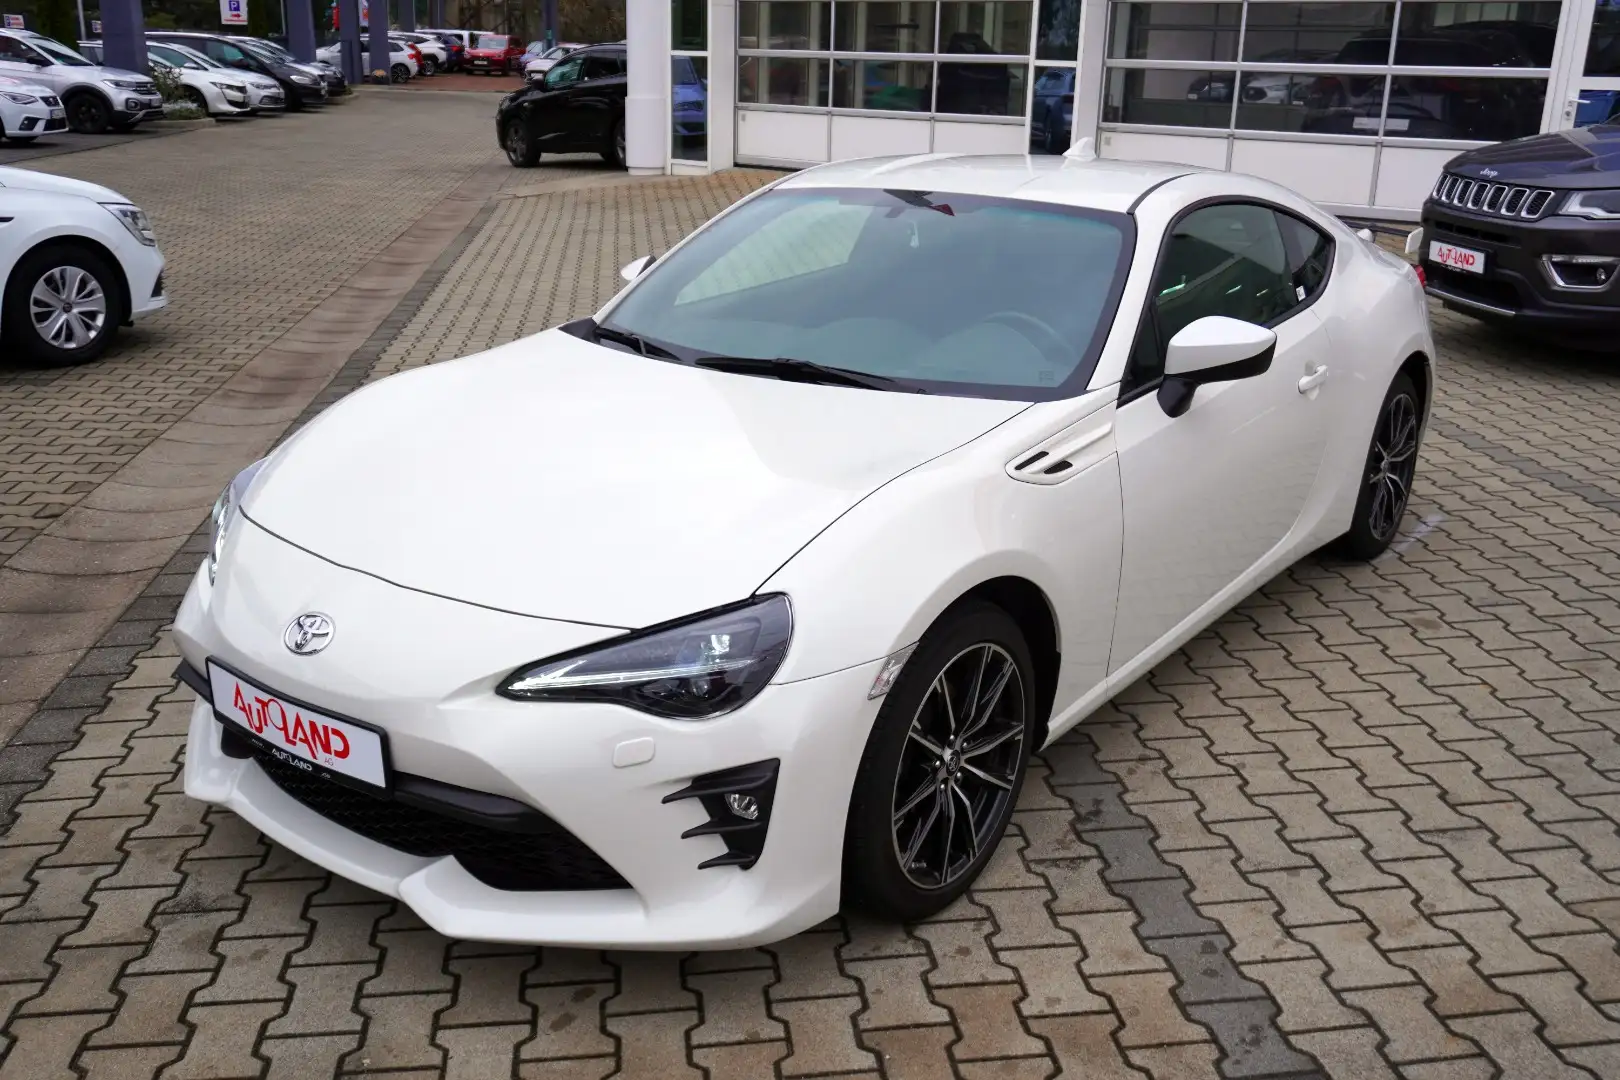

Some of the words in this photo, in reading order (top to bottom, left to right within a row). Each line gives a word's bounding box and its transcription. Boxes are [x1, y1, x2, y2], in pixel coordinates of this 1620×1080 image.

[231, 1, 238, 11] P
[1480, 168, 1499, 178] Jeep
[233, 681, 350, 760] AUTOLAND
